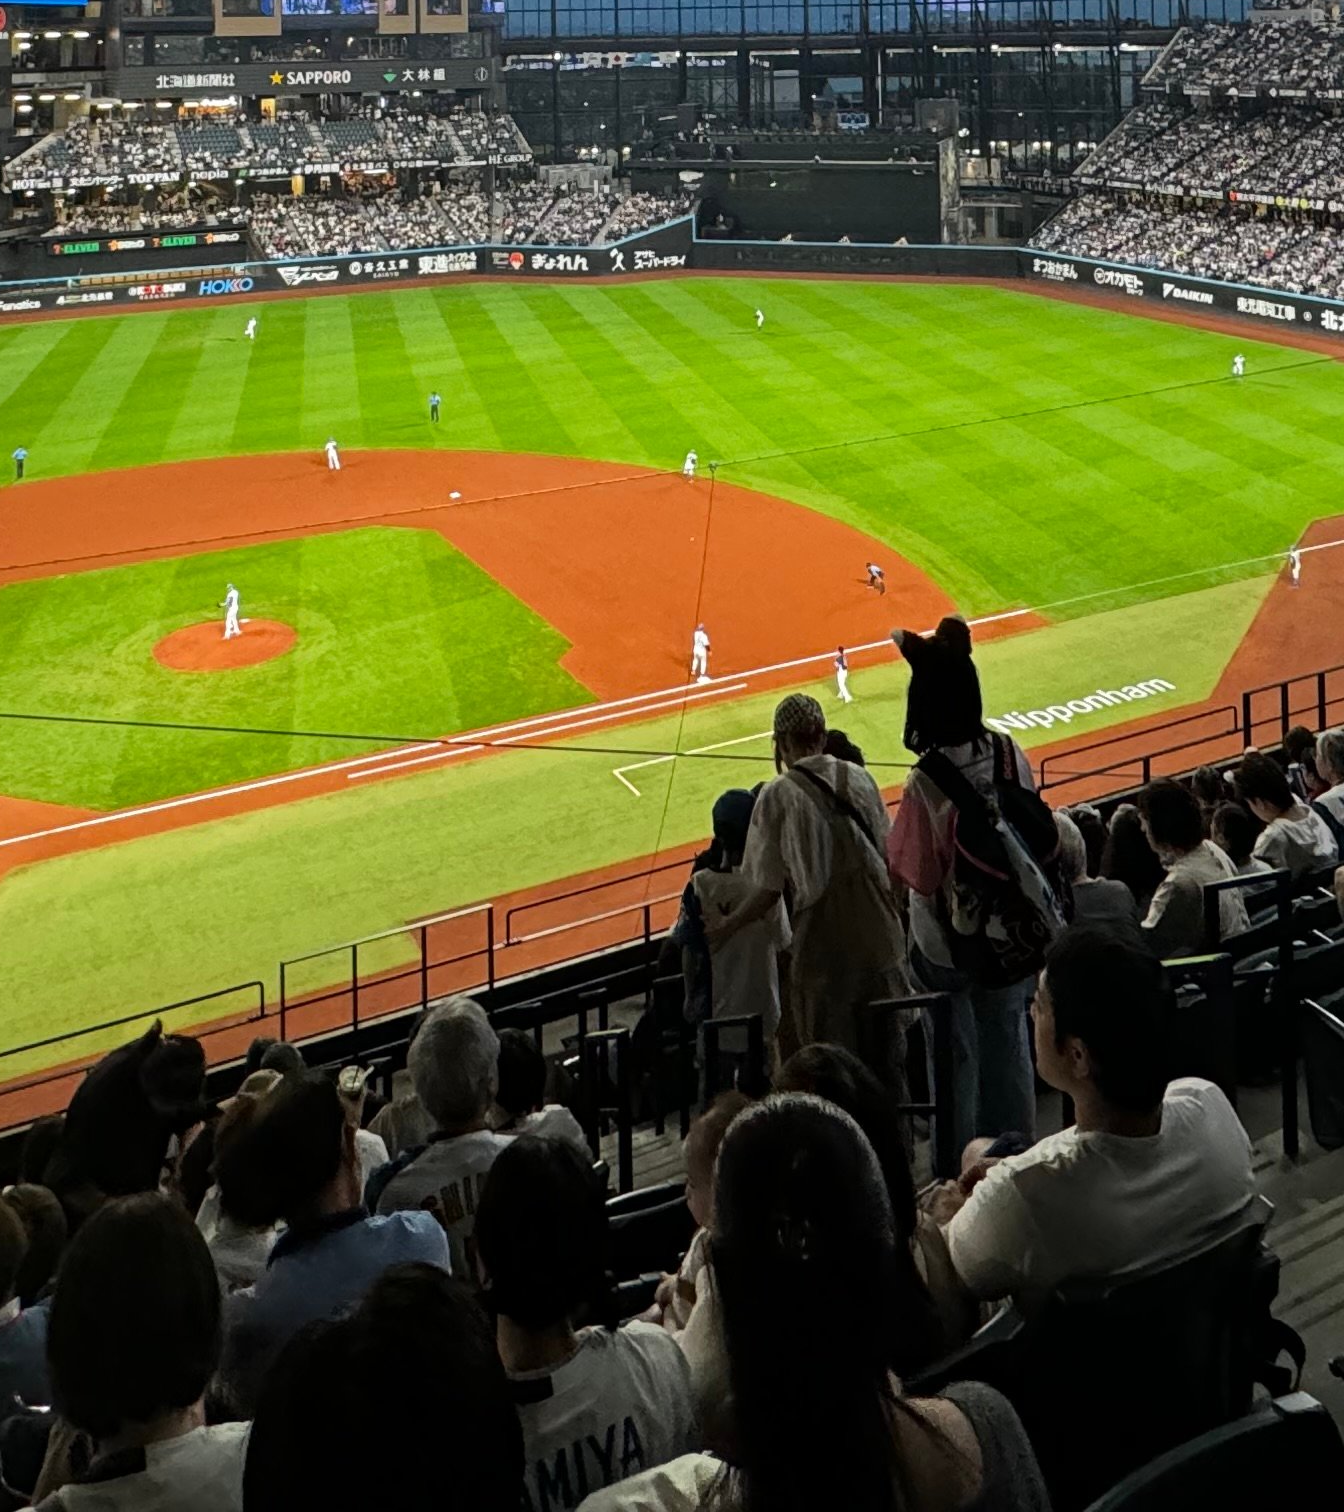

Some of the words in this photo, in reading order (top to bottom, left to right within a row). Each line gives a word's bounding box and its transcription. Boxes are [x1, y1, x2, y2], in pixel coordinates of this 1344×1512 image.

[287, 70, 352, 85] SAPPORO
[401, 68, 446, 82] 大林組
[127, 172, 181, 185] TOPPAN
[418, 255, 449, 275] 東進
[531, 254, 589, 271] ぎょれん
[634, 255, 687, 270] スーパードライ
[1105, 271, 1144, 288] オカモト
[1173, 287, 1214, 305] DAIKIN
[986, 678, 1177, 734] Nipponham
[536, 1416, 645, 1511] MIYA
